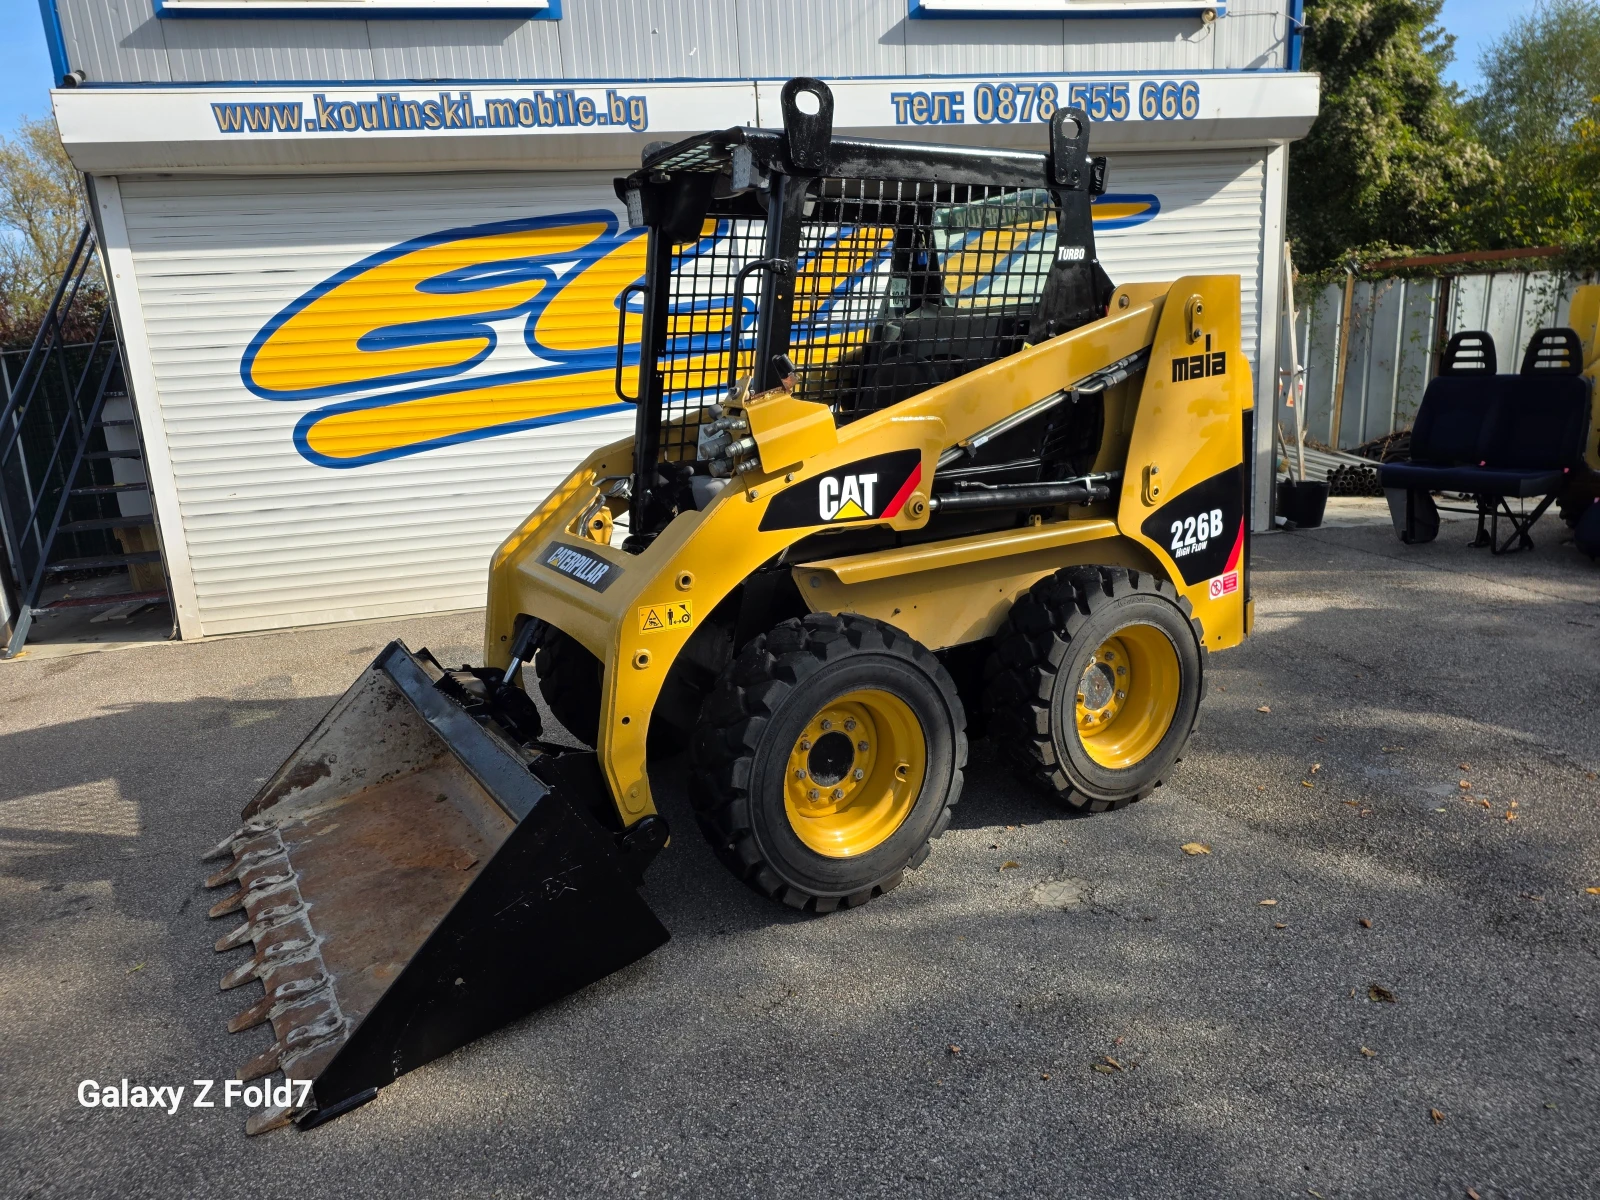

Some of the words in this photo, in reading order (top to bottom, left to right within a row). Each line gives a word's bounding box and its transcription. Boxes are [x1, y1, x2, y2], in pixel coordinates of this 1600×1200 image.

[210, 89, 649, 133] www.koulinski.mobile.bg
[890, 91, 965, 125] тел:
[973, 82, 1059, 124] 0878
[1068, 81, 1130, 122] 555
[1138, 80, 1200, 121] 666
[1057, 246, 1085, 261] TURBO
[1172, 334, 1226, 383] maia
[819, 473, 878, 520] CAT
[1170, 508, 1223, 550] 226B
[547, 546, 610, 585] CATERPILLAR
